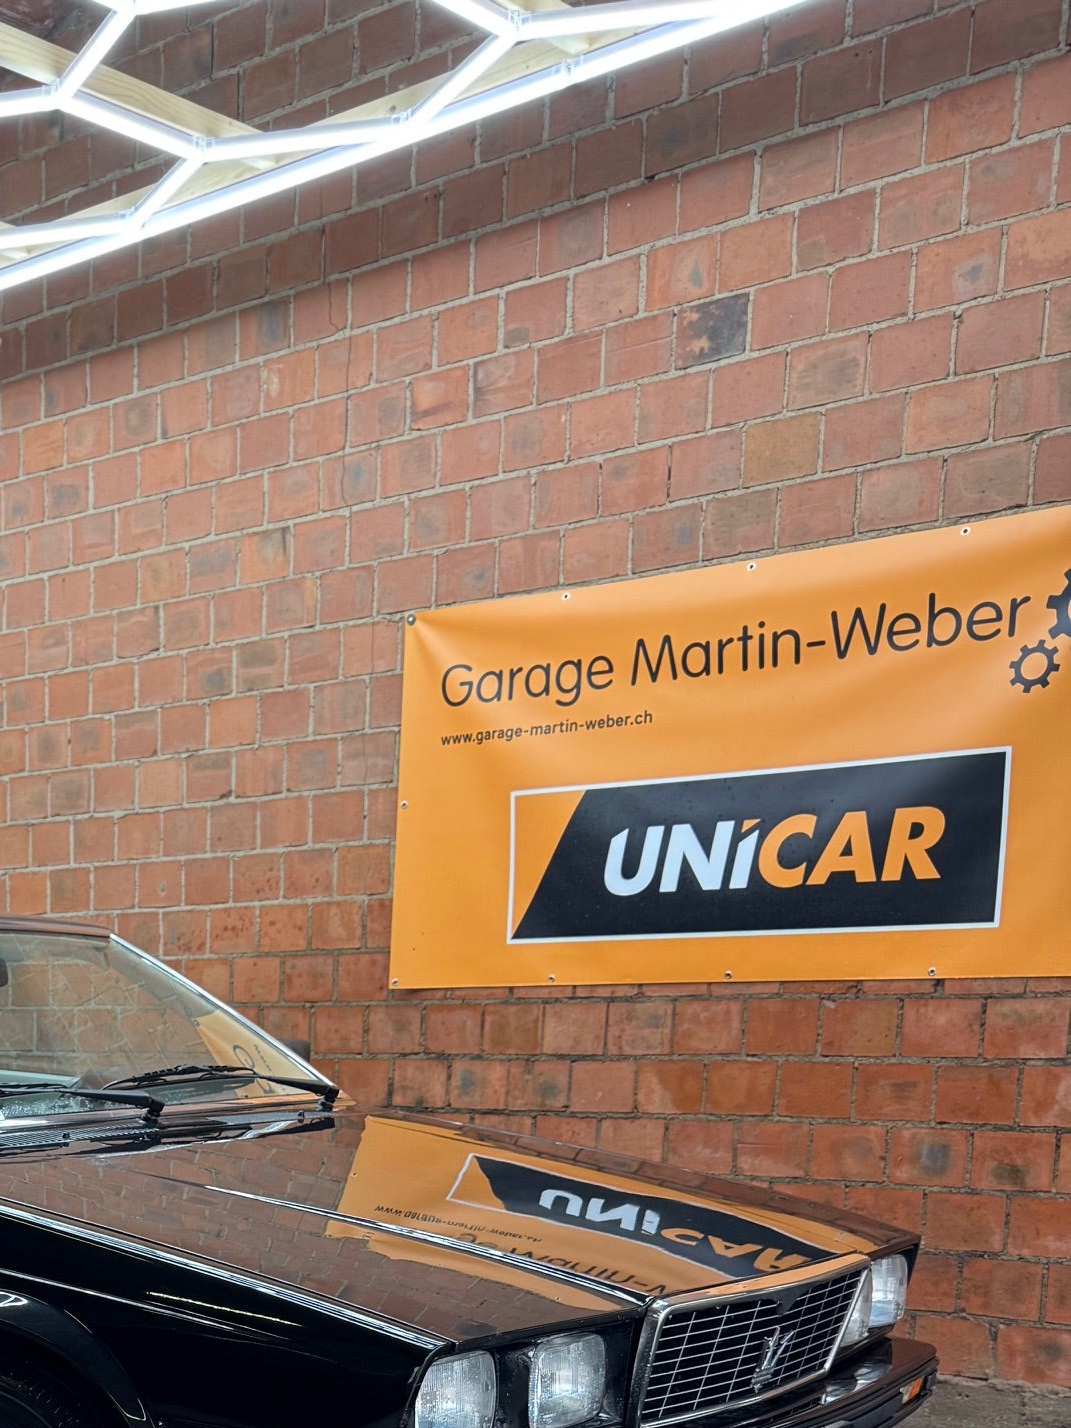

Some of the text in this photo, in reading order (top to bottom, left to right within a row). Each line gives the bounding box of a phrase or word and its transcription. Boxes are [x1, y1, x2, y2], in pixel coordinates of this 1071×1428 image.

[441, 593, 1031, 707] Garage Martin-Weber
[441, 710, 653, 746] www.garage-martin-weber.ch
